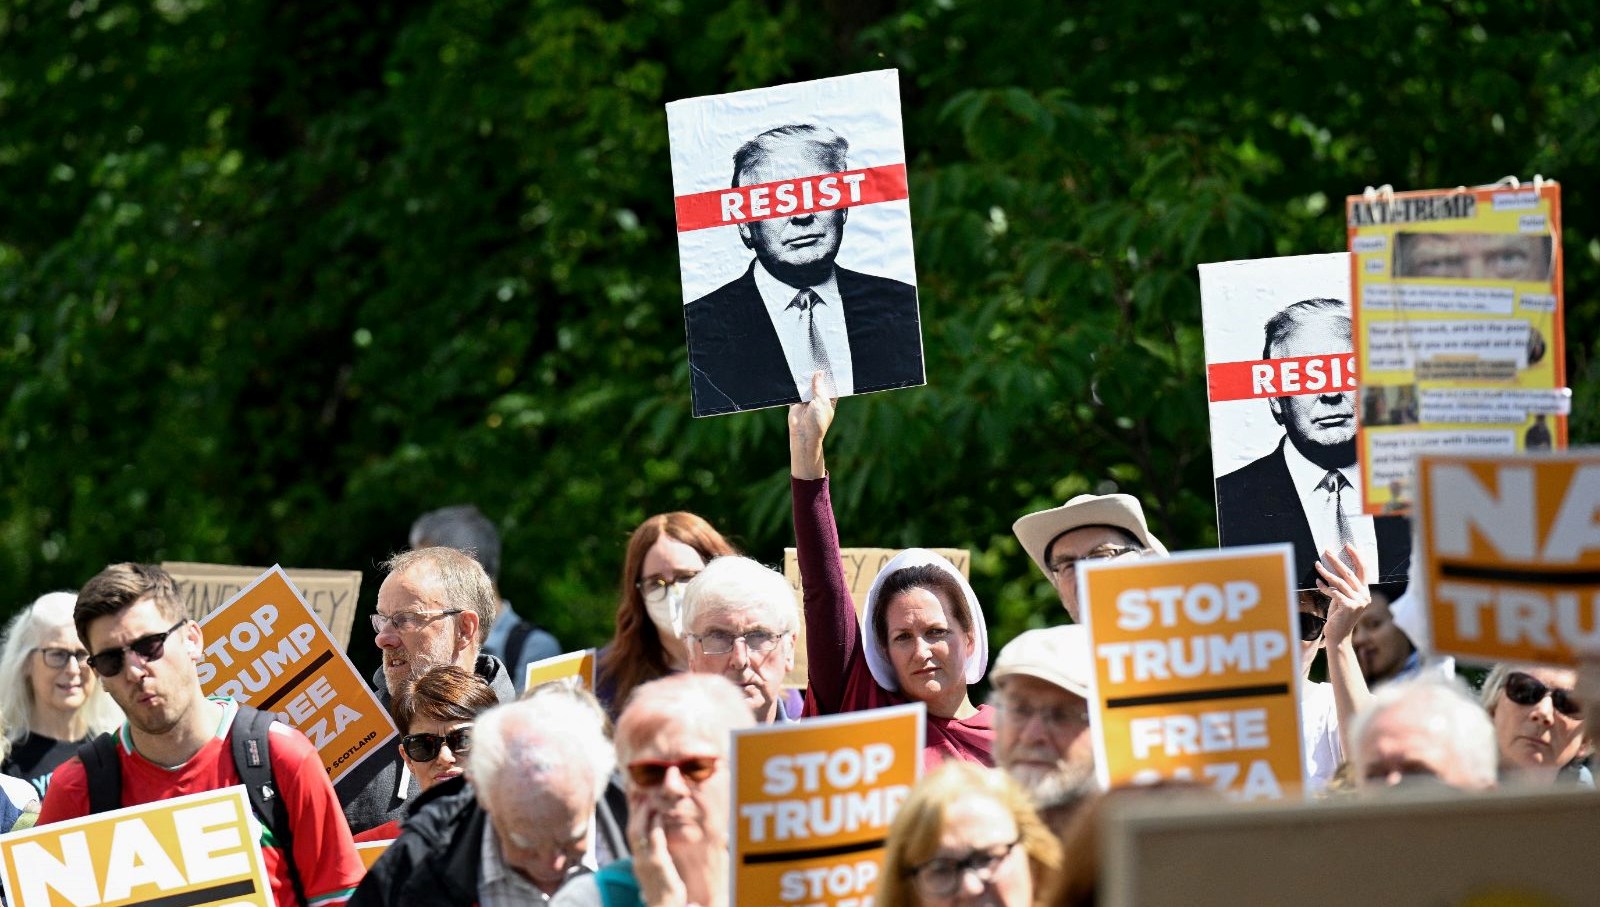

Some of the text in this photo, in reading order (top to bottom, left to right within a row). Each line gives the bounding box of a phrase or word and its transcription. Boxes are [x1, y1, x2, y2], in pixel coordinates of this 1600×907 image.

[720, 172, 866, 222] RESIST
[1116, 580, 1260, 631] STOP
[207, 622, 316, 704] RUMP
[1098, 630, 1288, 684] TRUMP
[306, 703, 364, 752] ZA
[332, 731, 378, 768] SCOTLAND
[1129, 708, 1270, 760] FREE
[762, 742, 895, 795] STOP
[1131, 760, 1282, 798] ZA
[10, 799, 251, 907] NAE
[779, 860, 880, 901] STOP
